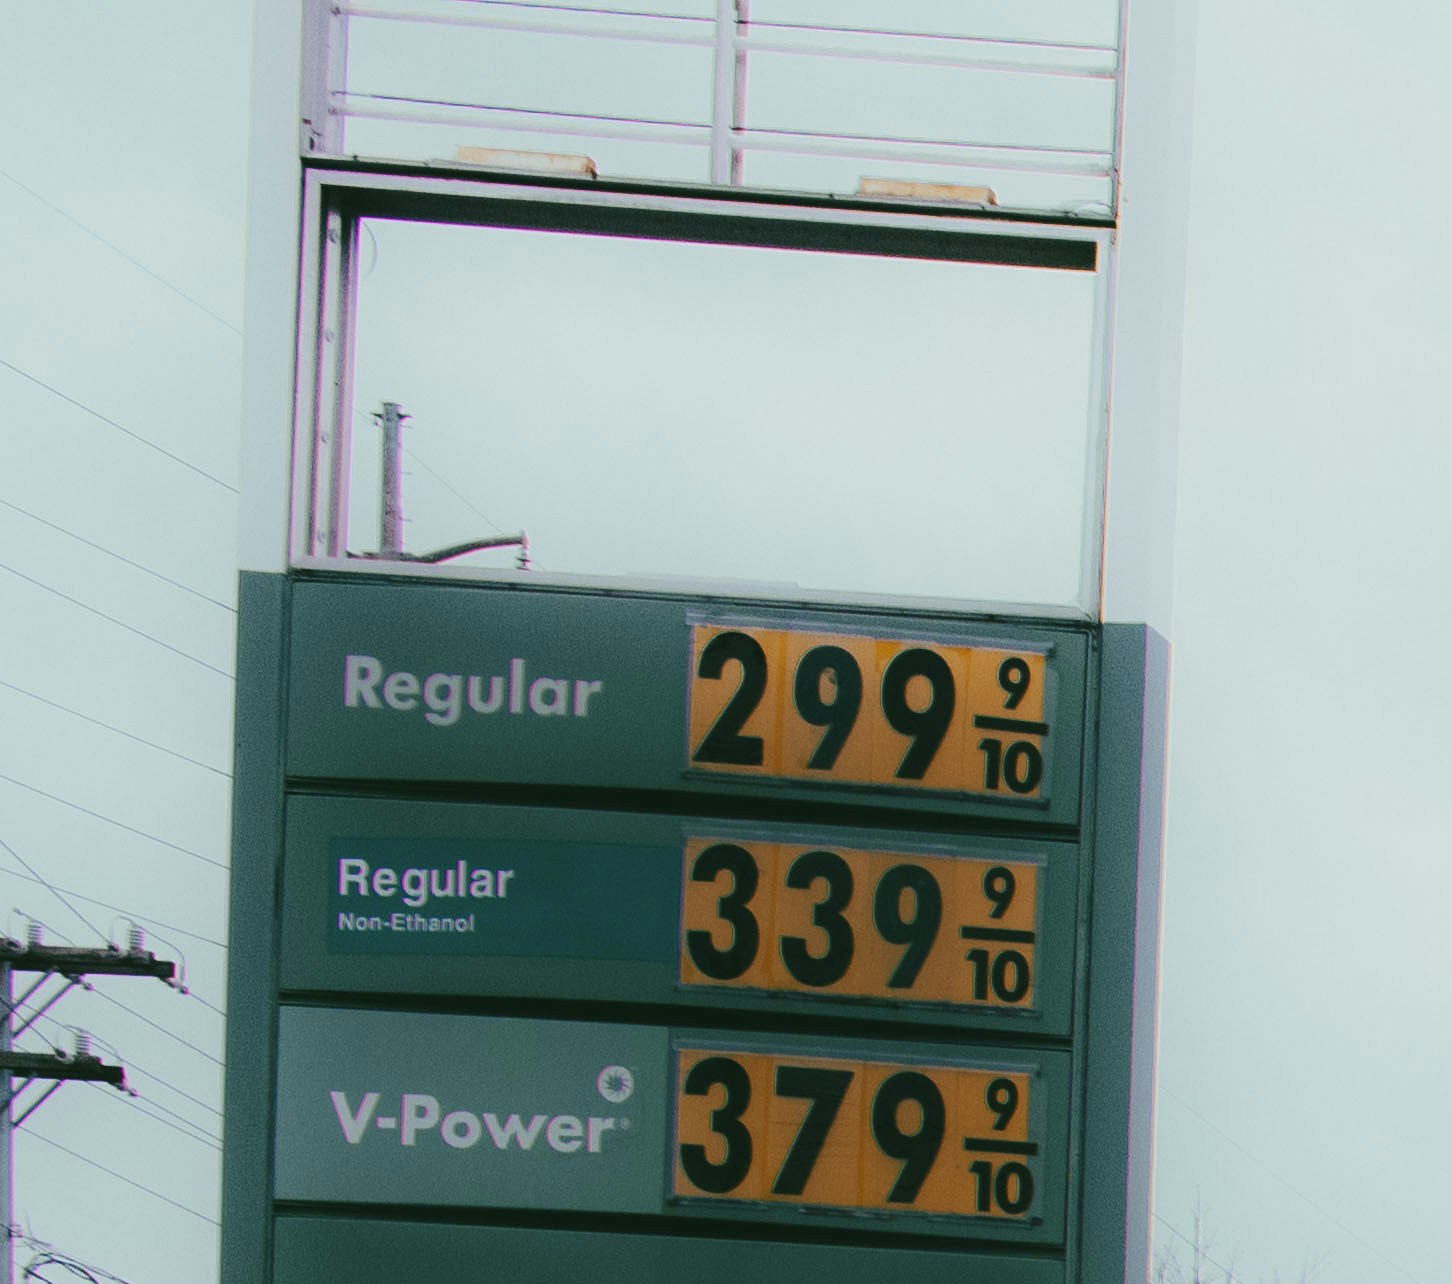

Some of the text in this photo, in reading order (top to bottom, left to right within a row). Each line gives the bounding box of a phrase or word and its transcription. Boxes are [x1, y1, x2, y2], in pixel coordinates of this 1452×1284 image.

[343, 653, 602, 726] Regular
[693, 630, 957, 781] 299
[978, 738, 1044, 795] 10
[337, 857, 514, 907] Regular
[337, 912, 476, 934] Non-Ethanol
[685, 843, 943, 990] 339
[965, 946, 1031, 1003] 10
[330, 1090, 615, 1155] V-Power
[679, 1056, 946, 1205] 379
[968, 1159, 1035, 1217] 10
